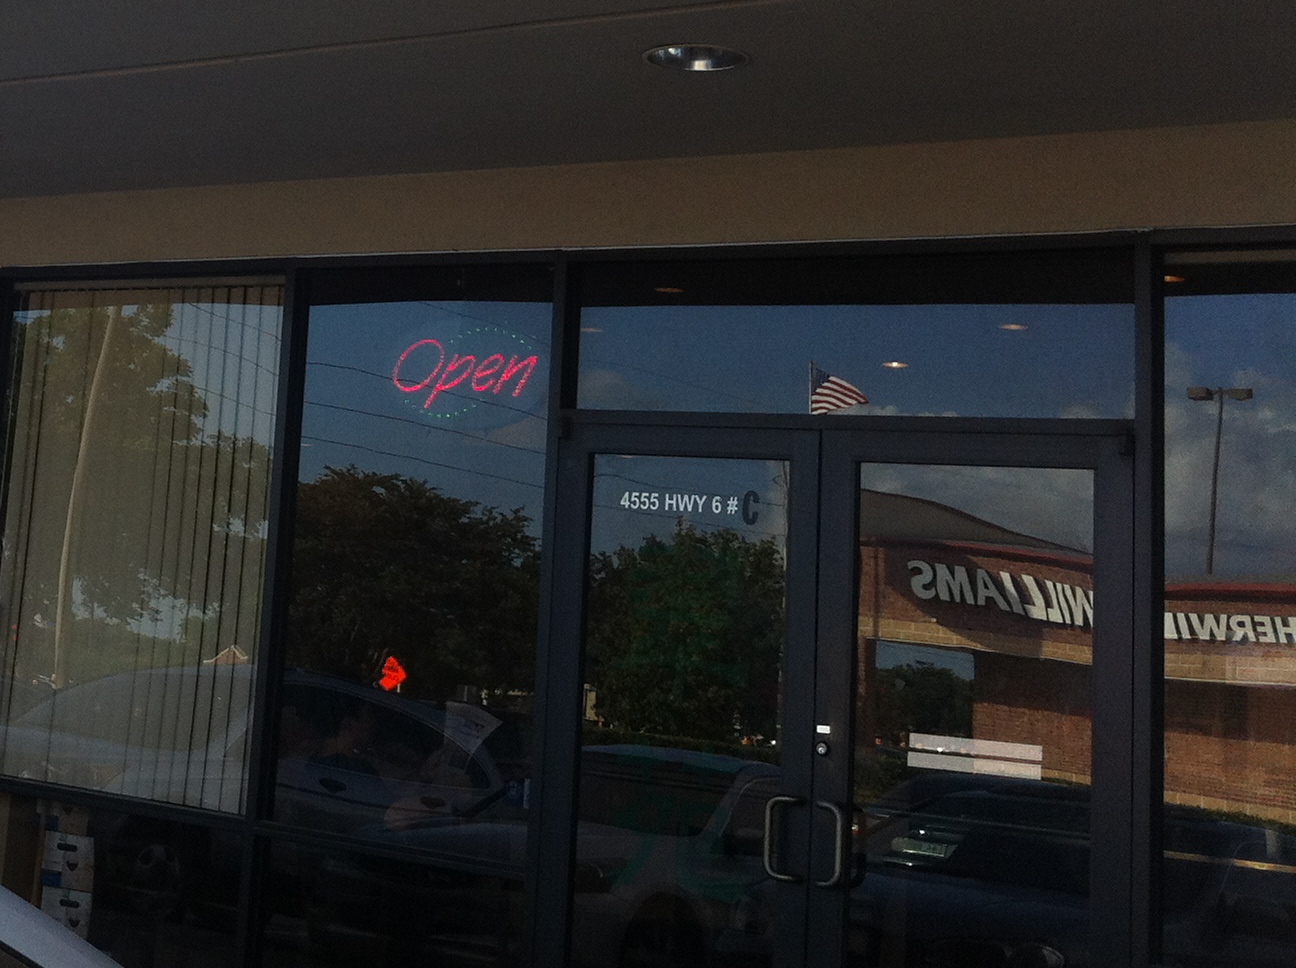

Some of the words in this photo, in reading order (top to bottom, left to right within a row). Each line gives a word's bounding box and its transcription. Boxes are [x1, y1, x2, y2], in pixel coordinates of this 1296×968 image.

[392, 338, 539, 409] Open
[620, 491, 659, 510] 4555
[664, 493, 706, 513] HWY
[711, 496, 722, 514] 6
